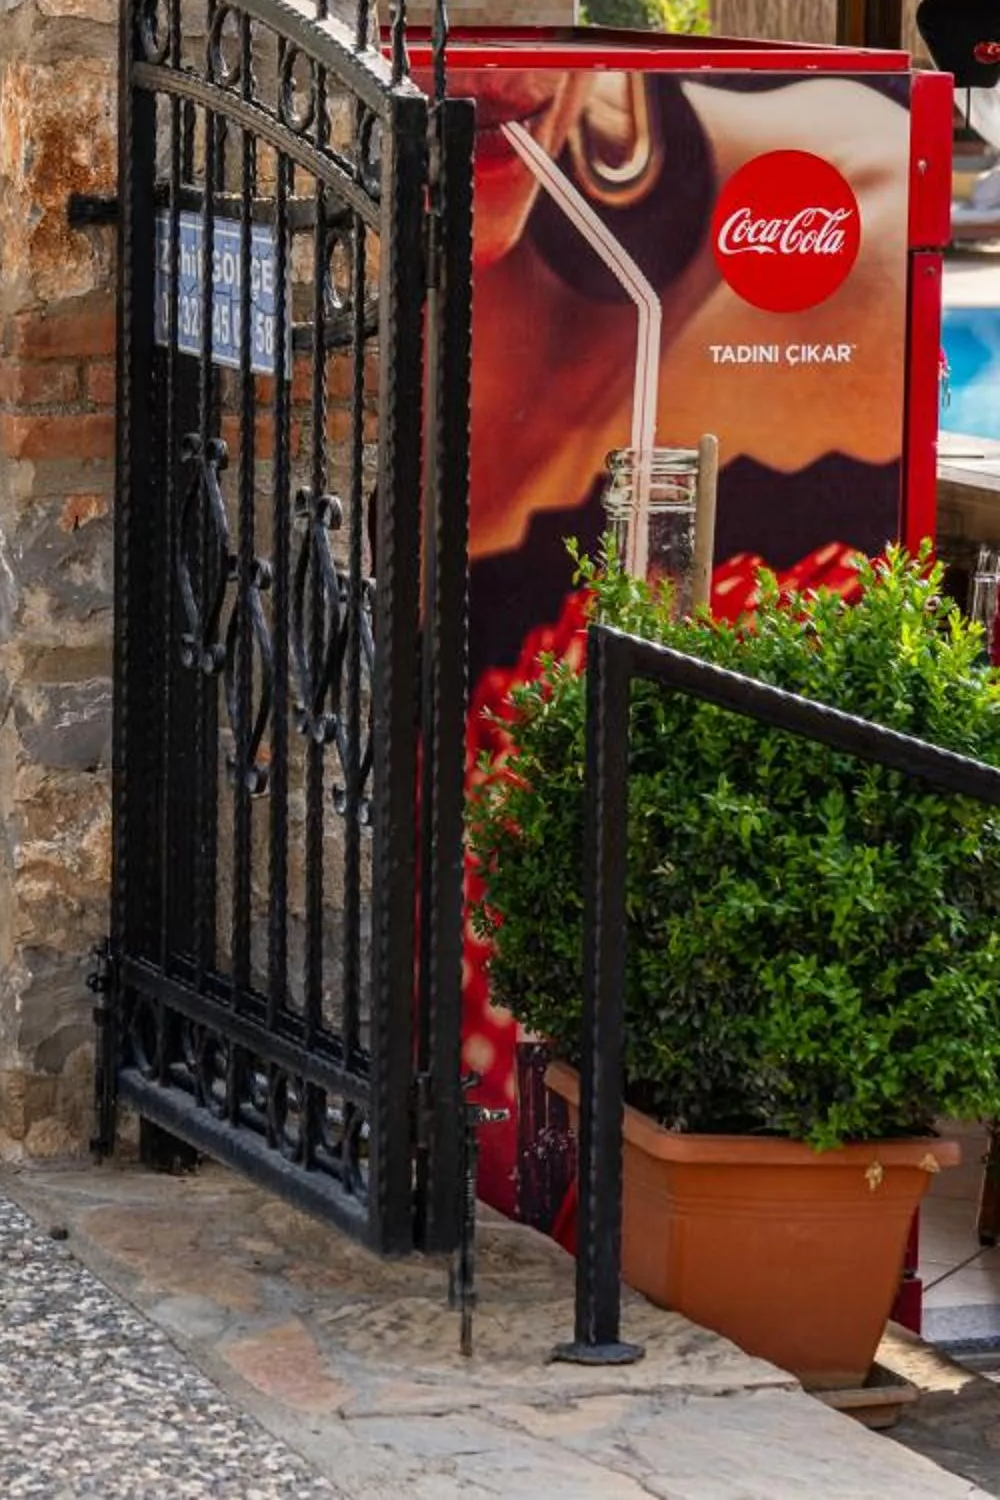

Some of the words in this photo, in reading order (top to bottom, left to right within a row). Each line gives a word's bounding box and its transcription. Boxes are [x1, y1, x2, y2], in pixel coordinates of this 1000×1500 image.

[717, 206, 853, 256] Coca-Cola
[709, 344, 779, 364] TADINI
[785, 344, 852, 367] ÇIKAR
